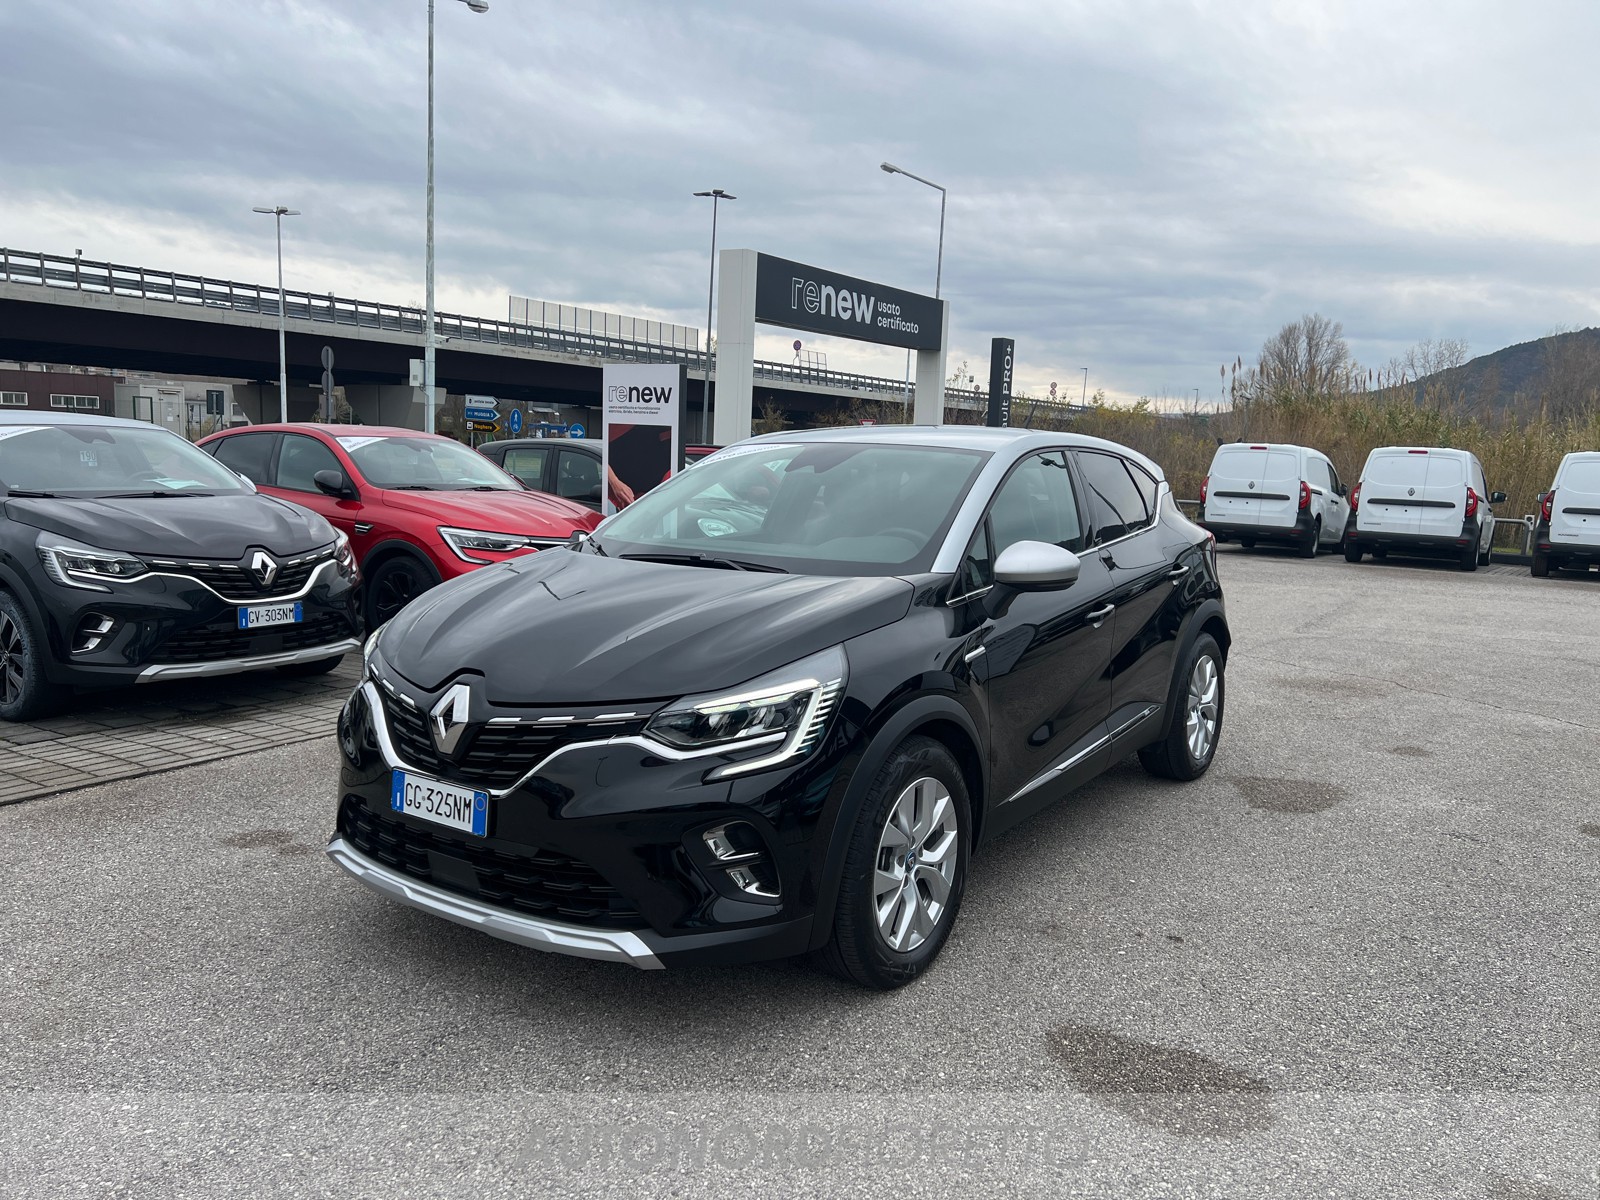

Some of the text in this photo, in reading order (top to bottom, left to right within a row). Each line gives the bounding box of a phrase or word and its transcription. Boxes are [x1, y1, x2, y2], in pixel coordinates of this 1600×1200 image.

[791, 277, 875, 325] renew
[877, 301, 901, 316] usato
[877, 316, 919, 334] certificato
[1002, 344, 1012, 395] PRO+
[608, 385, 673, 404] renew
